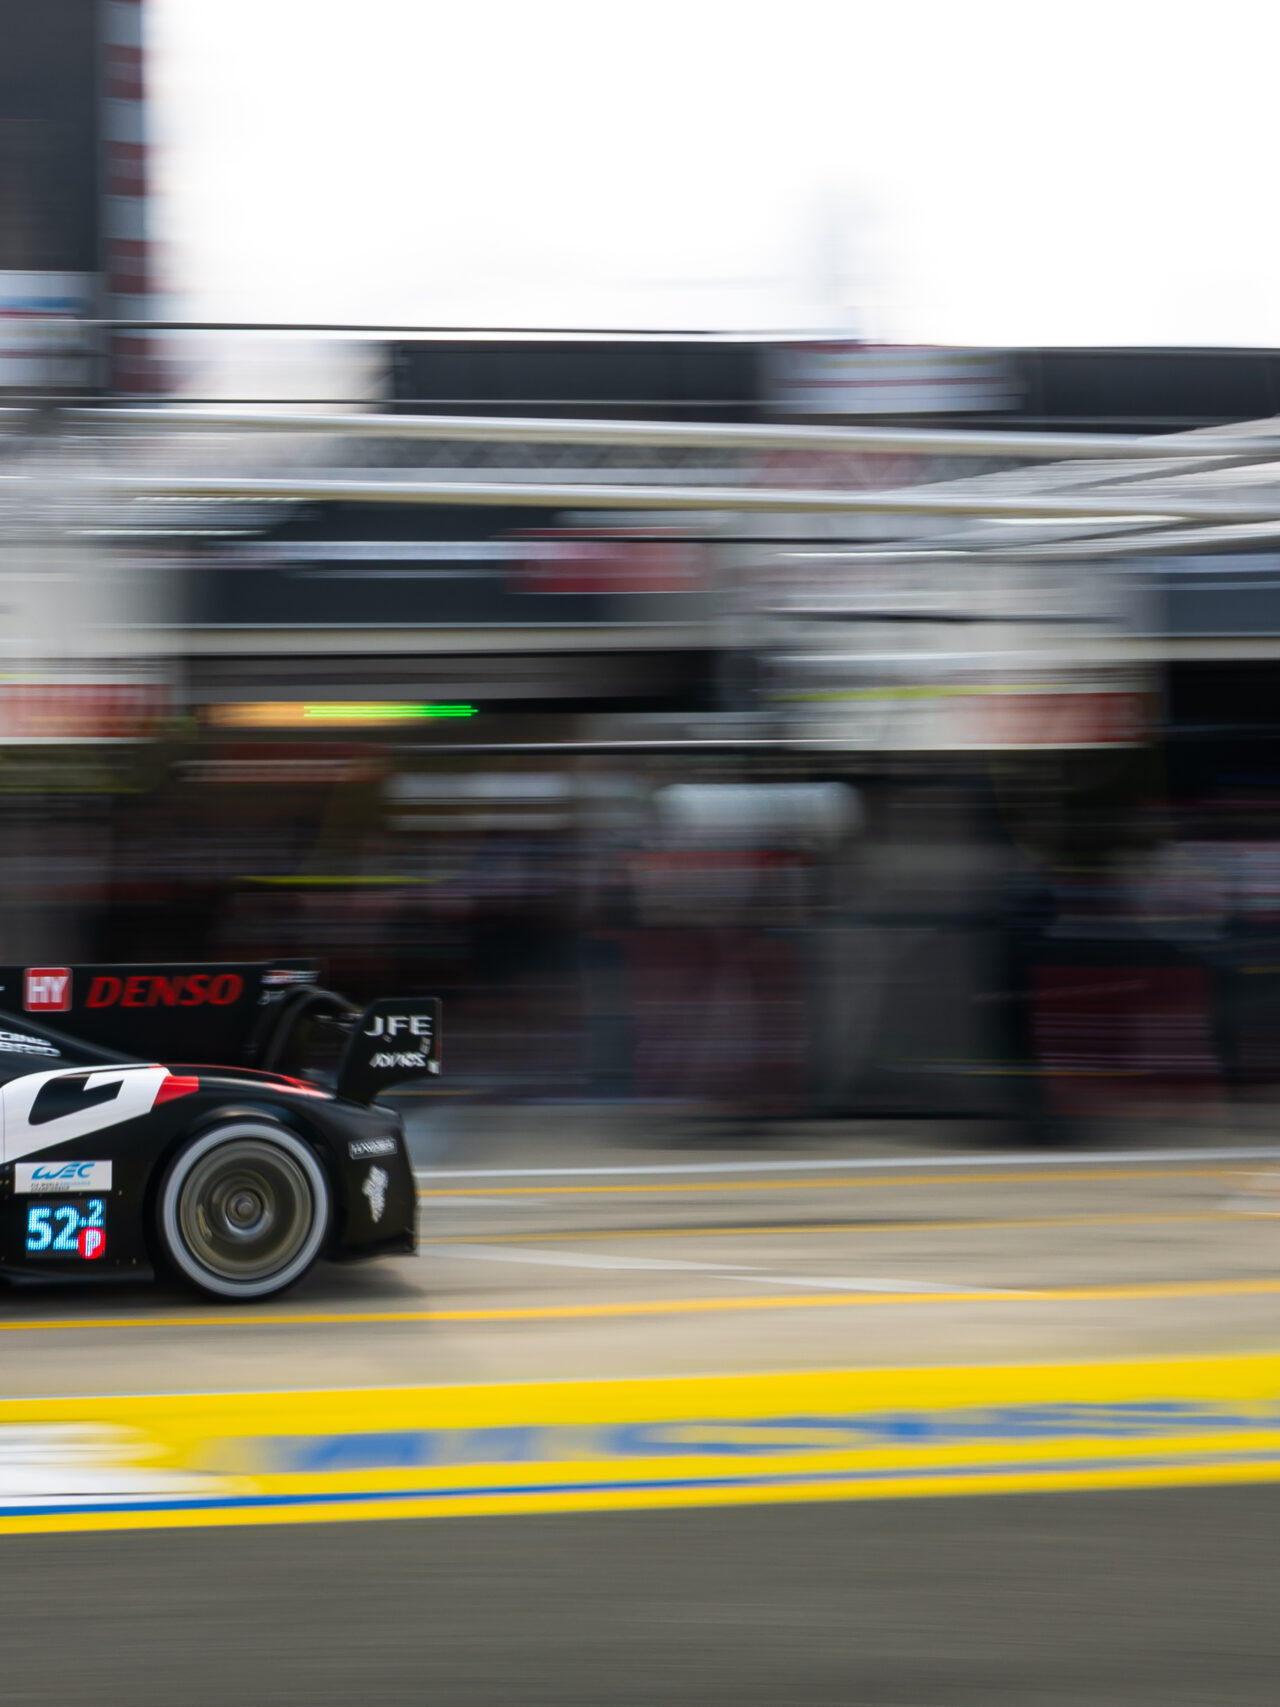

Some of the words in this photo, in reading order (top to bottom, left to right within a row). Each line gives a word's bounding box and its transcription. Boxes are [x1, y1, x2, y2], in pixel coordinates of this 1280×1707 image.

[28, 976, 69, 1004] HY
[85, 974, 243, 1008] DENSO
[363, 1015, 433, 1037] JFE
[31, 1162, 95, 1180] WEC
[85, 1229, 101, 1257] P
